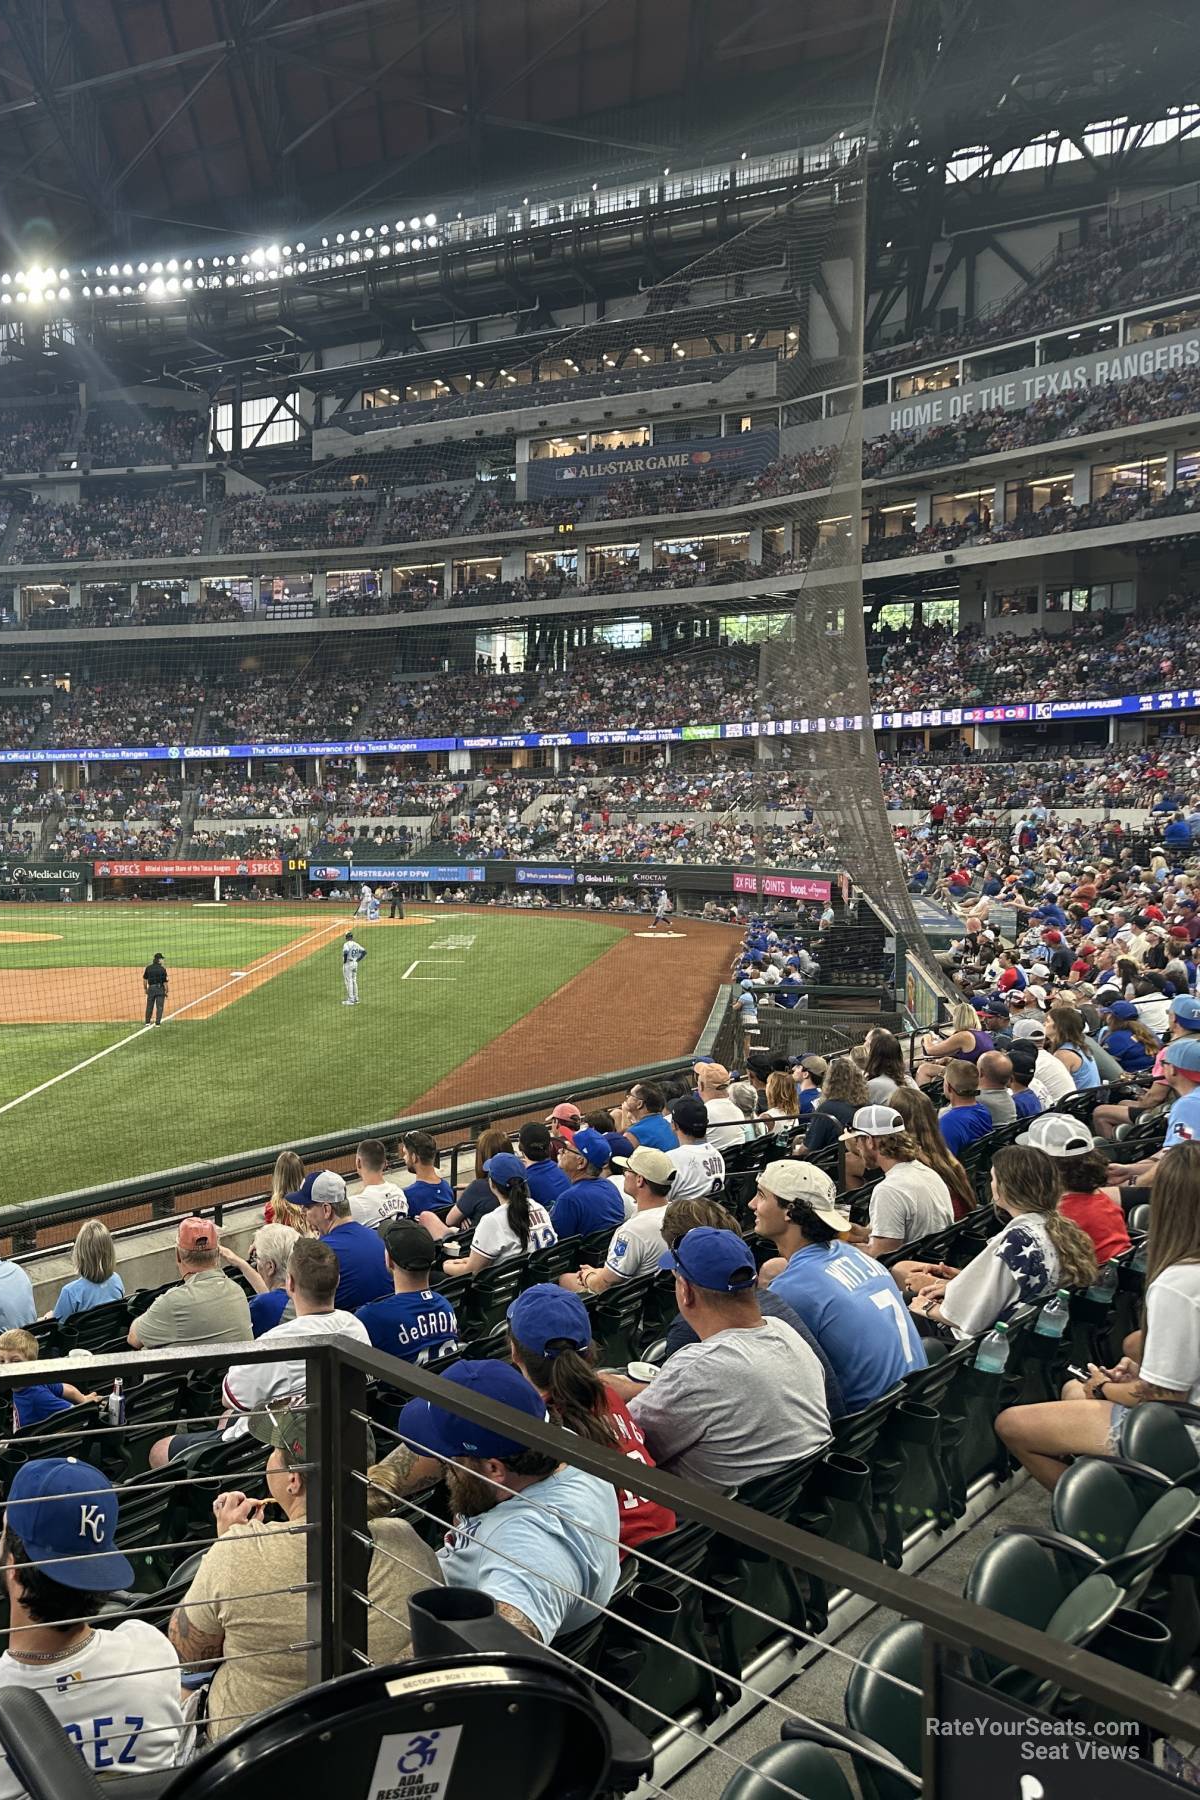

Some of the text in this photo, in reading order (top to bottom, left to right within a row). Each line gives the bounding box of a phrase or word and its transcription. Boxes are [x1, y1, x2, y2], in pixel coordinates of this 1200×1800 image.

[890, 339, 1200, 432] HOME OF THE TEXAS RANGERS
[646, 453, 690, 472] GAME
[1052, 703, 1087, 712] ADAM
[6, 752, 31, 760] Official
[32, 752, 45, 760] Life
[46, 751, 77, 760] Insurance
[79, 751, 86, 759] of
[87, 751, 100, 759] the
[120, 750, 149, 759] Rangers
[184, 745, 230, 757] Globe Life
[252, 742, 416, 755] The Official Life Insurance of the Texas Rangers
[113, 863, 141, 874] SPEC'S
[214, 865, 231, 873] Rangers
[251, 861, 280, 873] SPEC'S
[350, 870, 395, 878] AIRSTREAM
[396, 870, 409, 878] OF
[409, 870, 430, 878] DFW
[28, 869, 81, 881] Medical City
[602, 874, 614, 883] Life
[614, 875, 628, 883] Field
[736, 878, 744, 888] 2X
[744, 878, 758, 890] FUE
[761, 880, 786, 893] POINTS
[702, 1155, 724, 1177] SOTO
[824, 1256, 868, 1292] WITT
[398, 1311, 458, 1345] deGROM
[869, 1288, 913, 1364] 7
[78, 1504, 106, 1545] KC
[397, 1773, 425, 1788] ADA
[375, 1782, 441, 1800] RESERVED
